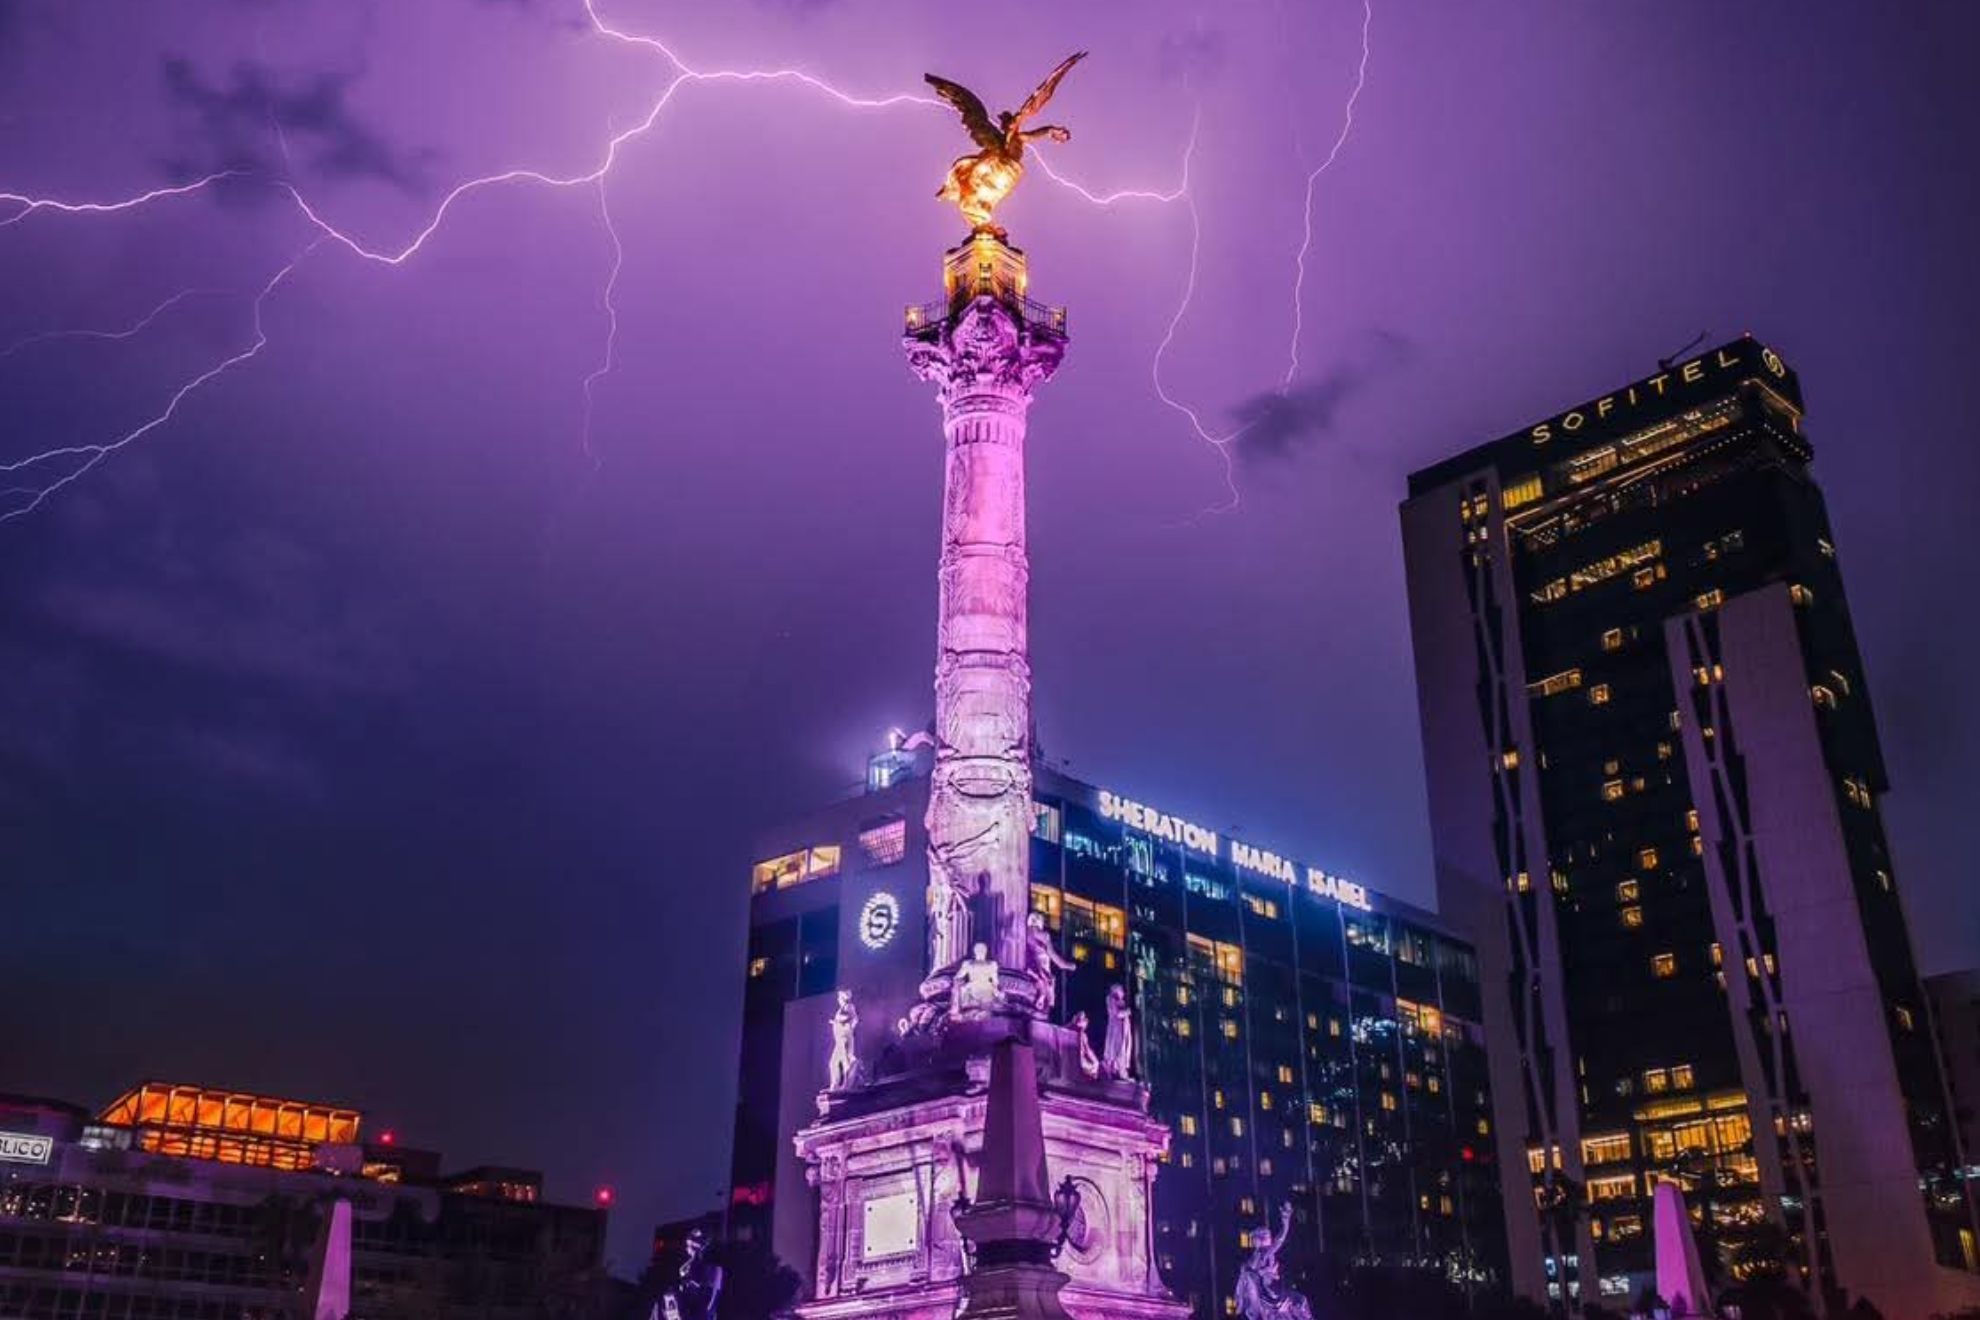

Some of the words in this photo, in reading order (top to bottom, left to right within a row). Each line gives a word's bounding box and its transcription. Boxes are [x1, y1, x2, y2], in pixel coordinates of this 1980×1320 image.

[1532, 350, 1740, 444] SOFITEL
[1098, 790, 1217, 855] SHERATON
[1231, 840, 1297, 885] MARIA
[1308, 867, 1372, 912] ISABEL
